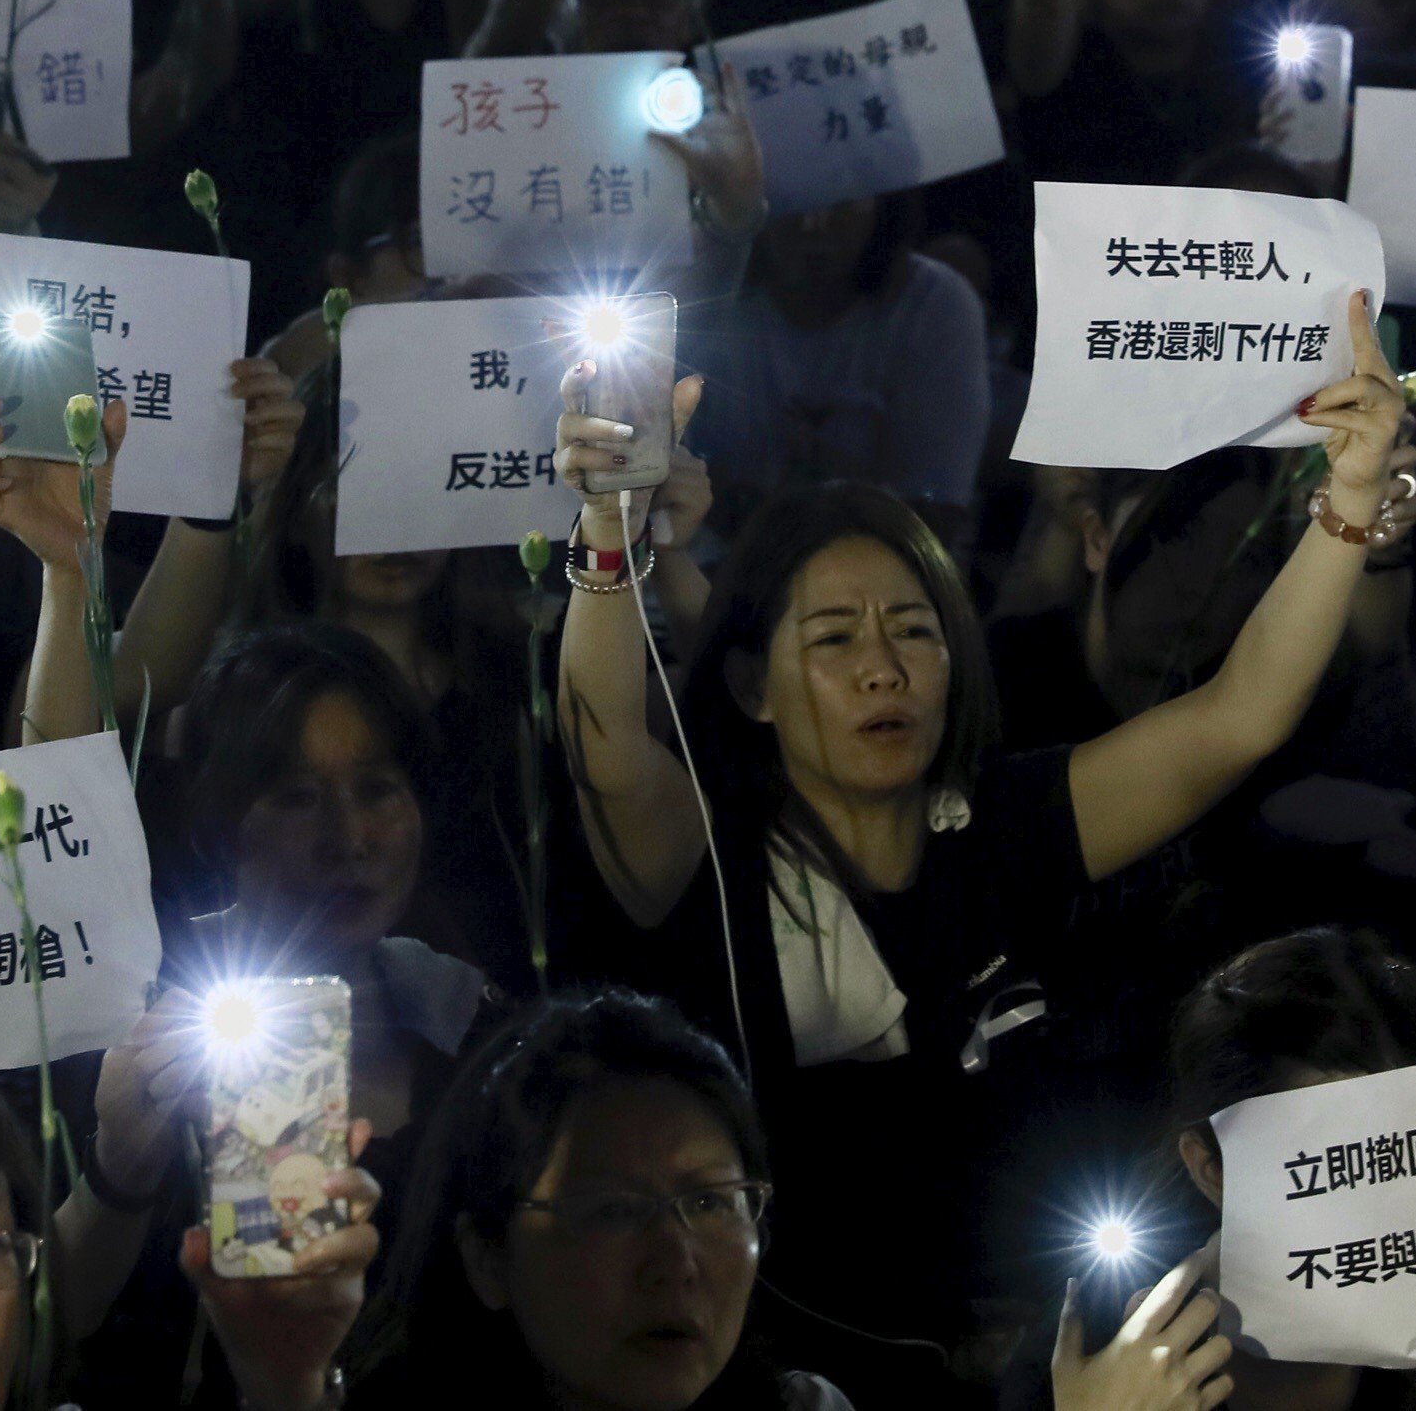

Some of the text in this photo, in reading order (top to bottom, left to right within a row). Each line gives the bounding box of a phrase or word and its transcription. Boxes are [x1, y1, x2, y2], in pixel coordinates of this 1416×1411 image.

[743, 24, 937, 105] 堅定的母親
[440, 77, 561, 136] 孩子
[821, 96, 890, 142] 力量
[1084, 316, 1331, 364] 香港還剩下什麼
